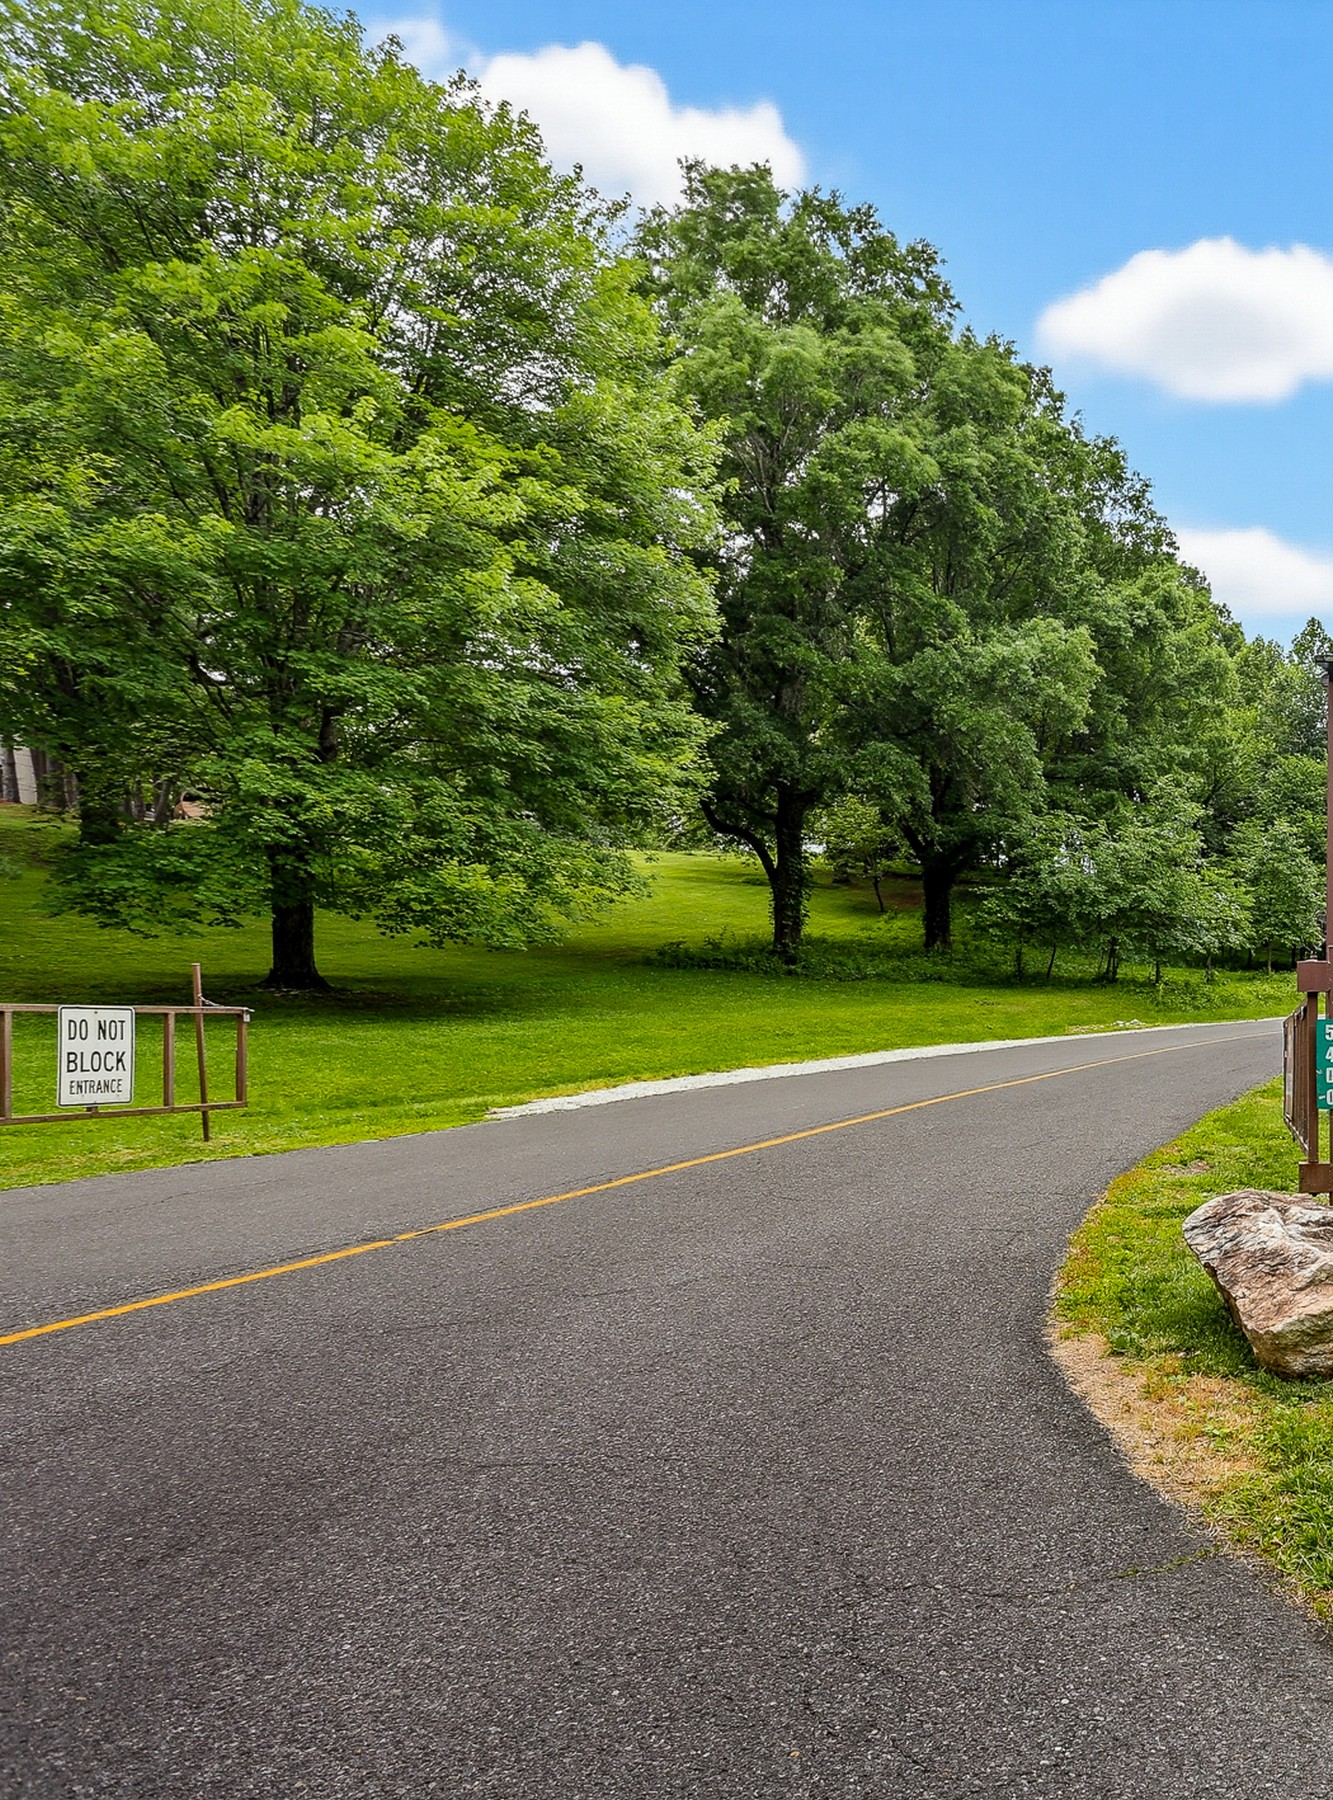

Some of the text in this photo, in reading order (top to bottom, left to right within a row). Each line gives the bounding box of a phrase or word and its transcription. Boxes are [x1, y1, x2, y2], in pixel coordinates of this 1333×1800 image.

[68, 1019, 126, 1041] DO NOT
[66, 1051, 126, 1073] BLOCK
[69, 1079, 123, 1095] ENTRANCE
